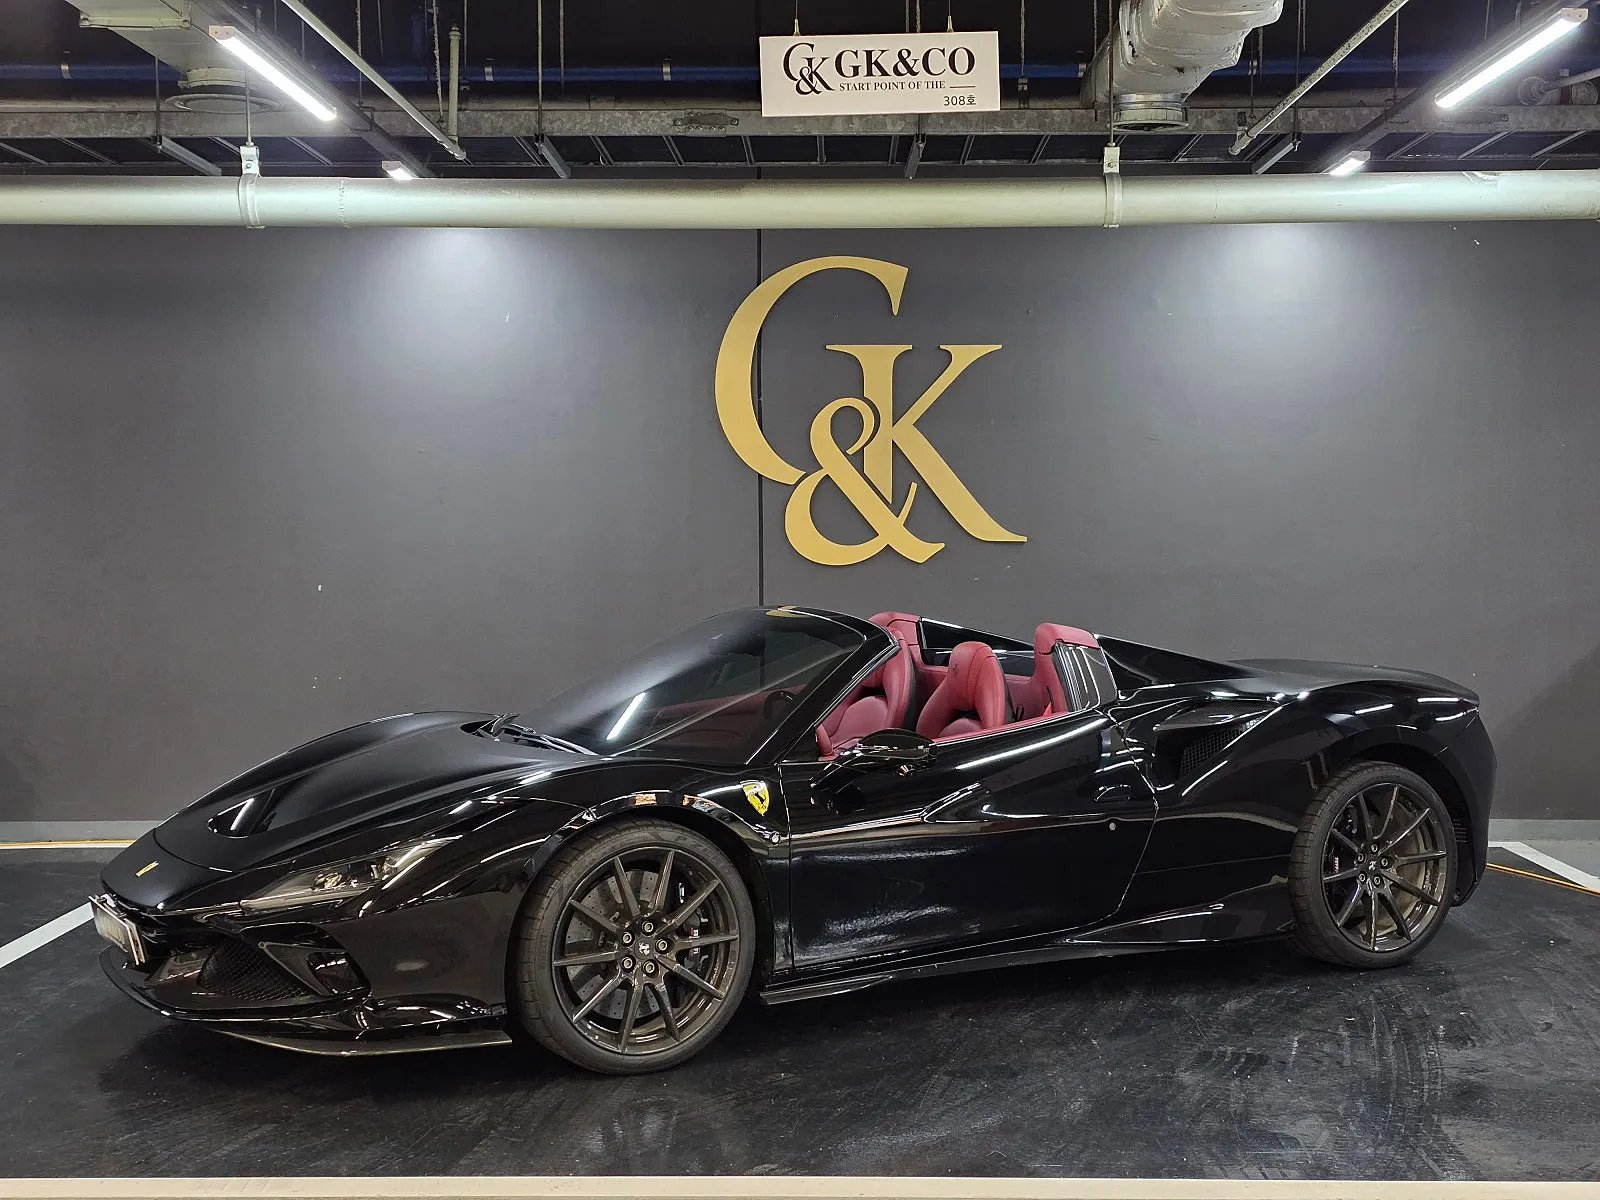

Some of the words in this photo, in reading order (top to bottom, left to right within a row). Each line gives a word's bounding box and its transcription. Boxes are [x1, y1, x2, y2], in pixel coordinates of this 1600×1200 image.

[835, 47, 976, 79] GK&CO
[839, 82, 871, 91] START
[874, 81, 906, 91] POINT
[908, 81, 922, 90] OF
[924, 80, 945, 89] THE
[943, 95, 976, 106] 308호
